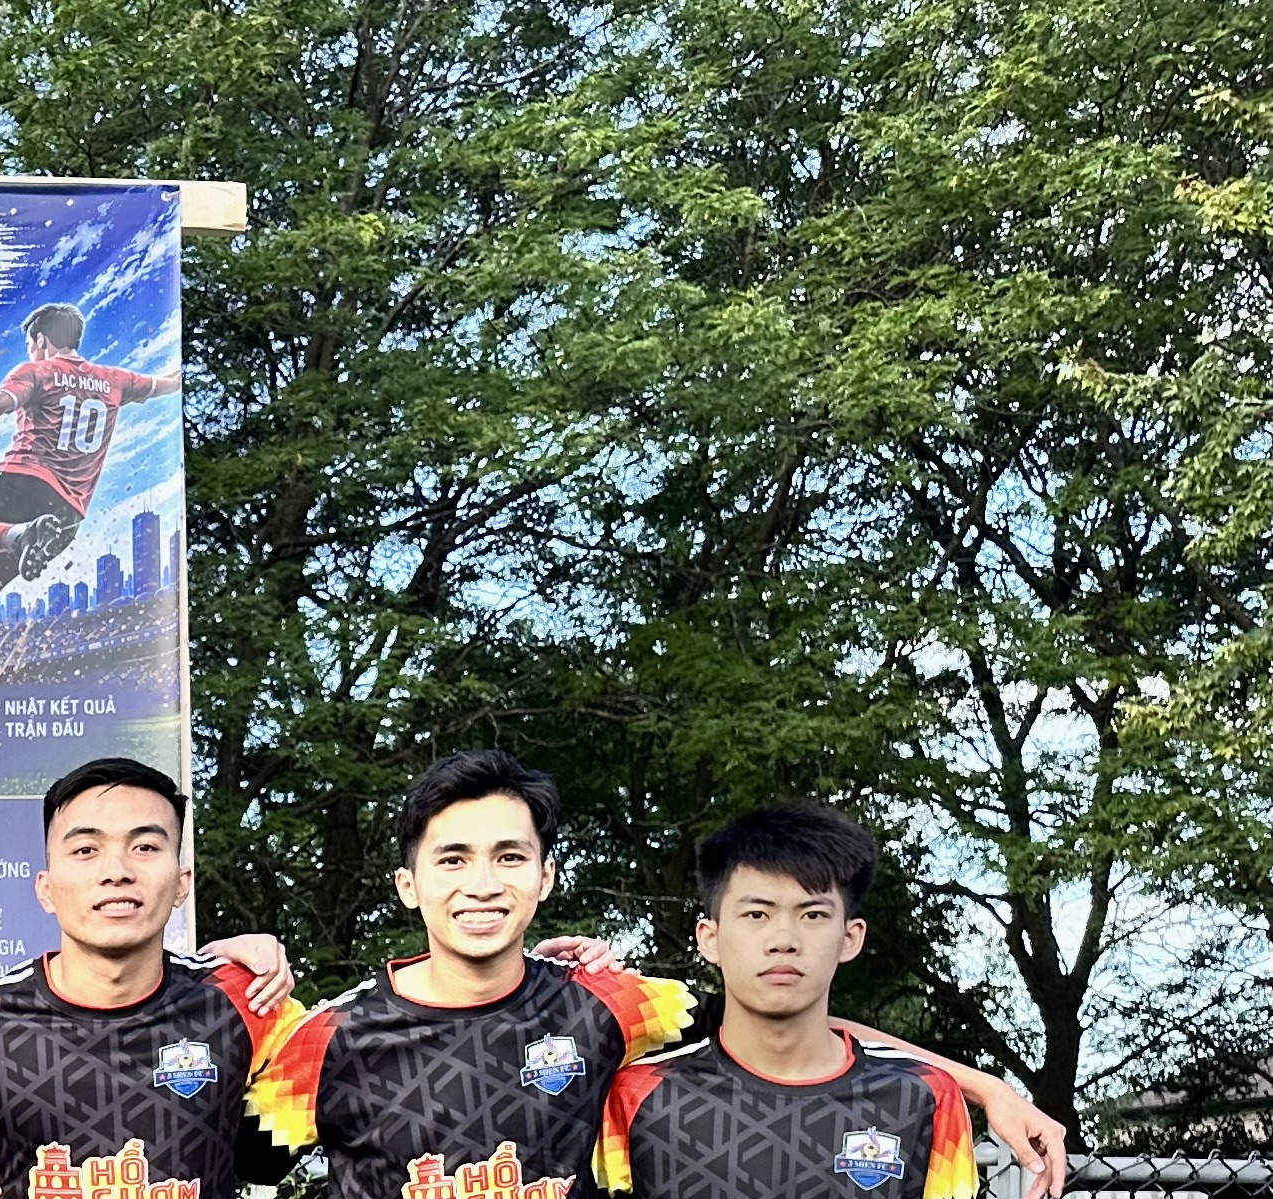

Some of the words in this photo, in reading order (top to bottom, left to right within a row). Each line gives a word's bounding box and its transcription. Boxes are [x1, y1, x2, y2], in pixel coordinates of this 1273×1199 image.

[54, 372, 76, 392] LẠC
[56, 394, 107, 454] 10
[4, 696, 47, 719] NHẬT
[50, 695, 80, 716] KẾT
[83, 694, 116, 716] QUẢ
[4, 718, 47, 741] TRẬN
[51, 716, 85, 737] ĐẤU
[89, 1142, 147, 1187] HỒ
[462, 1144, 519, 1193] HỒ
